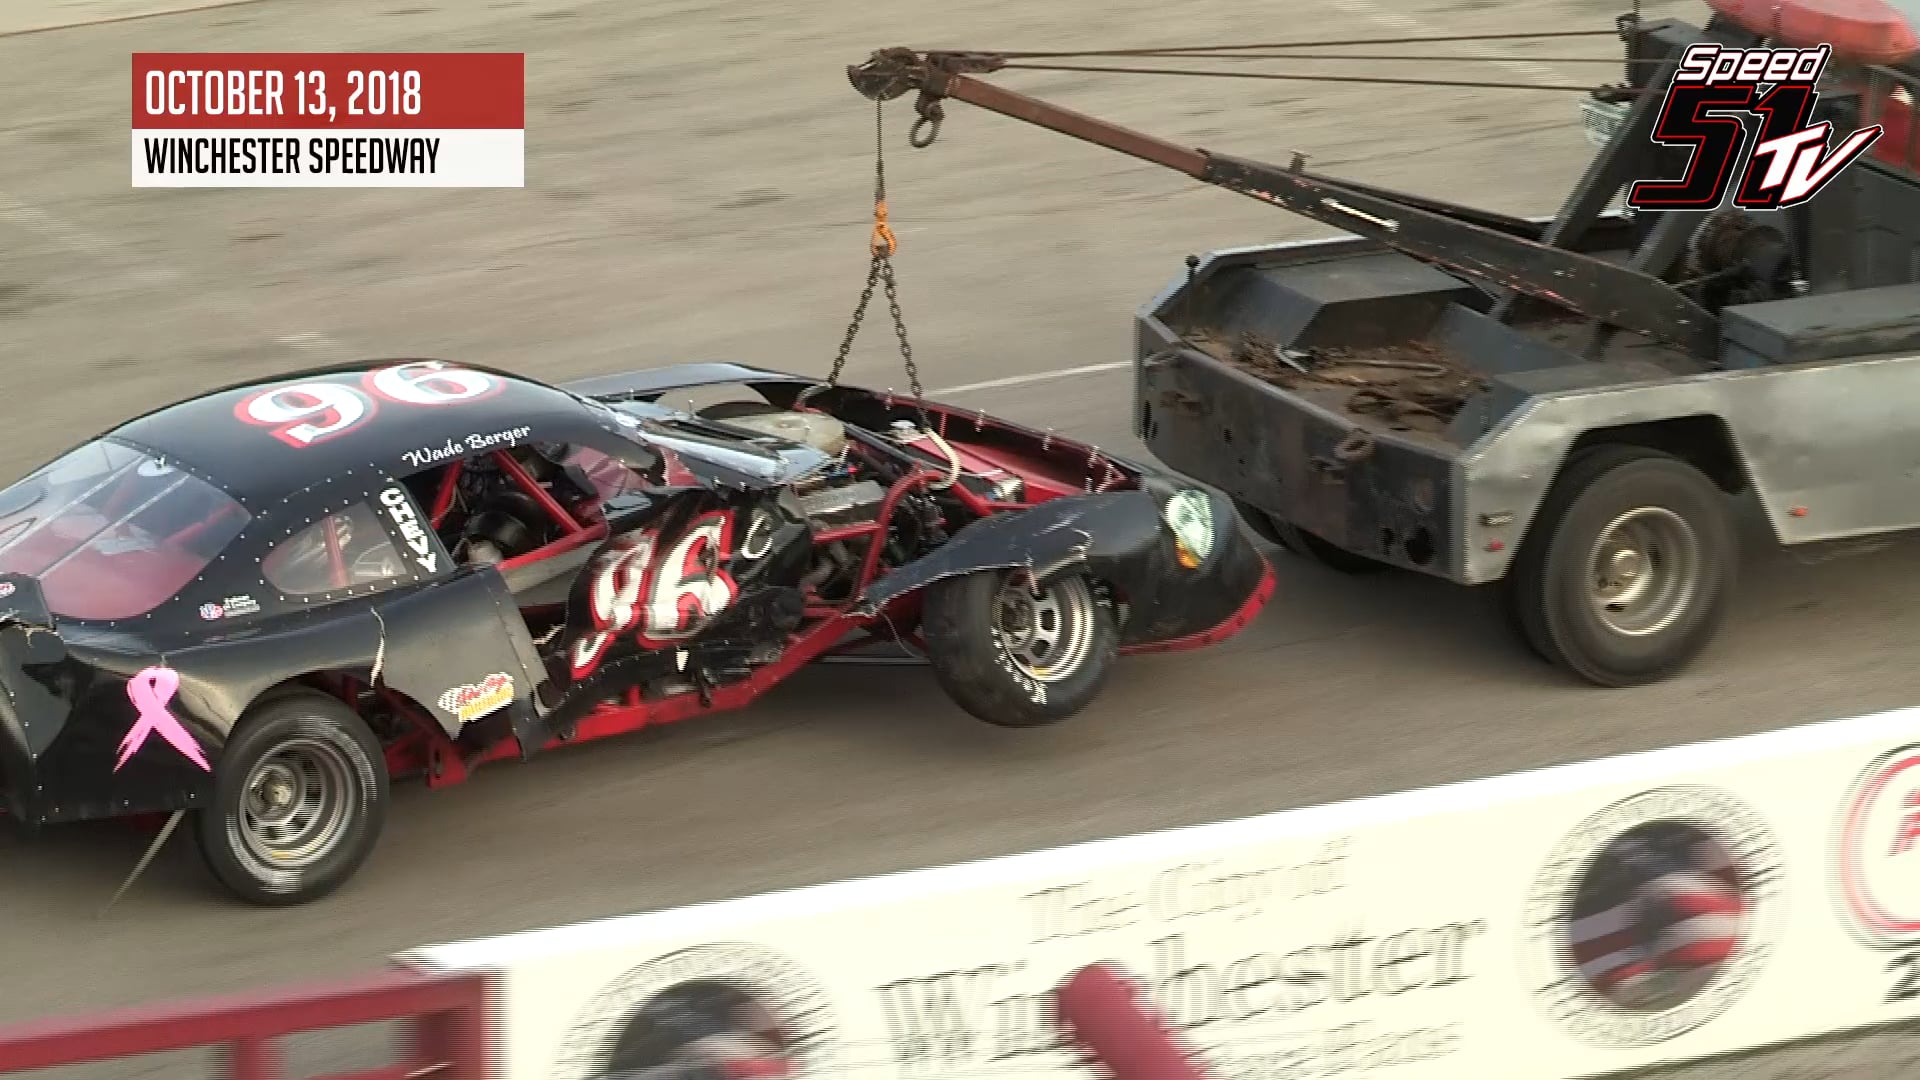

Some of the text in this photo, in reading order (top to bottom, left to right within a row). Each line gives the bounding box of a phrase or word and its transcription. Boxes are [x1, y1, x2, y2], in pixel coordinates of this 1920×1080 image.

[234, 360, 505, 448] 96
[402, 438, 464, 468] Wade
[380, 487, 437, 573] CHEVY
[874, 918, 1488, 1066] Wihester
